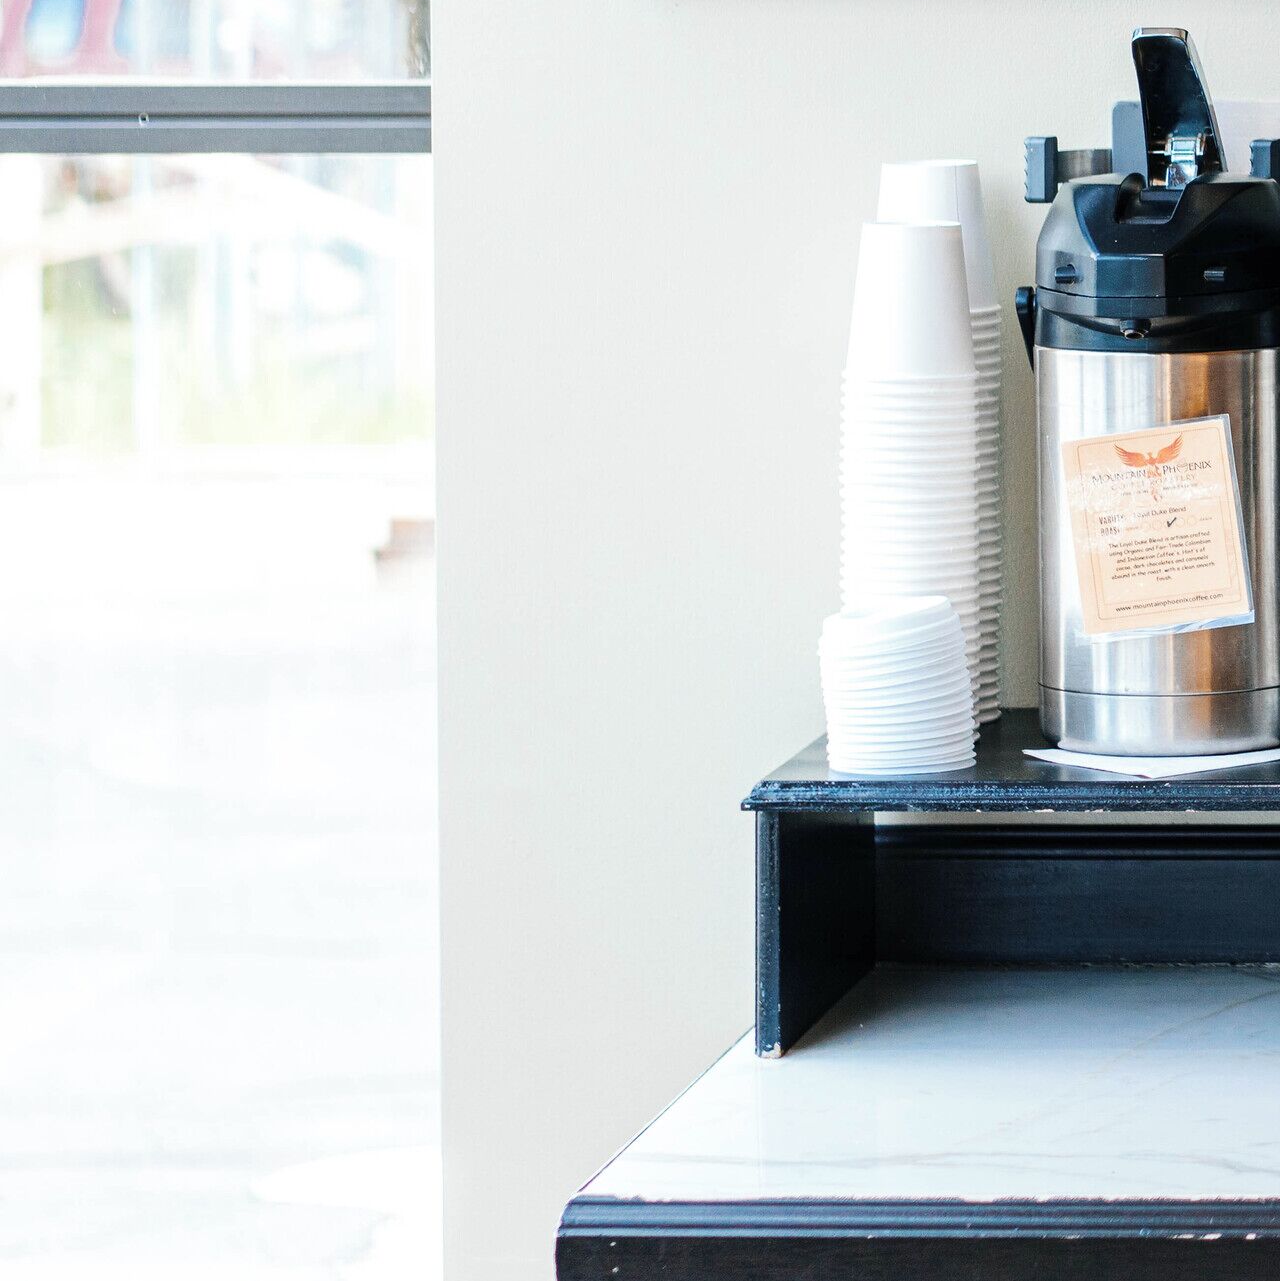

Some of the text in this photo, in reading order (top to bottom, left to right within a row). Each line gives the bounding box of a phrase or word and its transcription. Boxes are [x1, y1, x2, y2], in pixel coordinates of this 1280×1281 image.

[1091, 469, 1147, 485] MOUNTAIN
[1169, 506, 1188, 514] Blend
[1115, 593, 1224, 613] www.mountainphoenixcoffee.com
